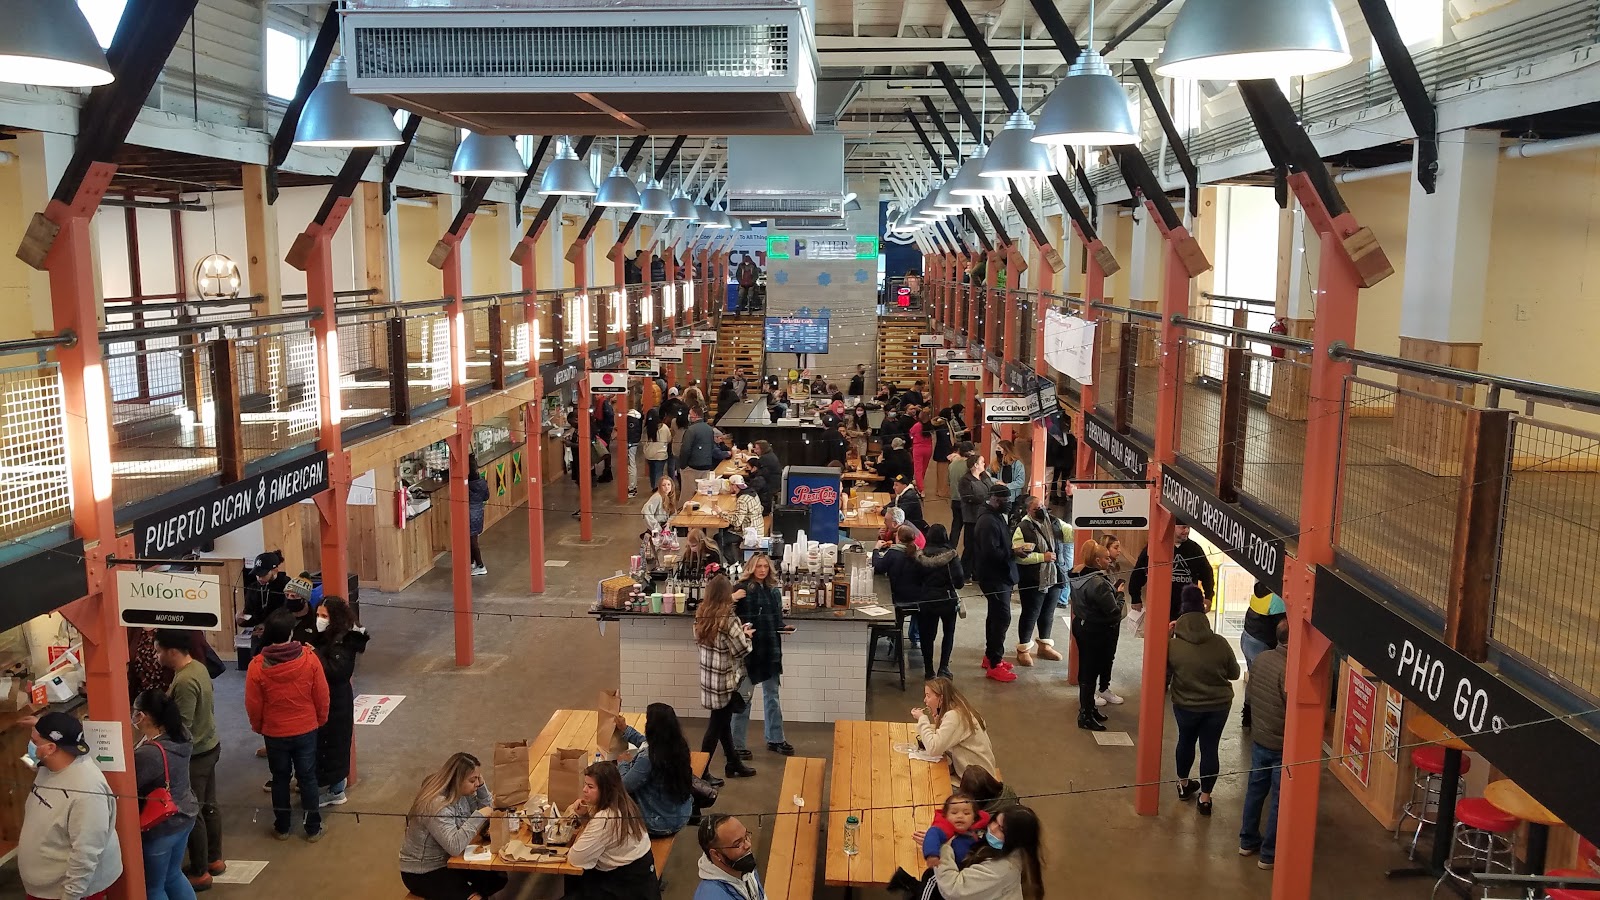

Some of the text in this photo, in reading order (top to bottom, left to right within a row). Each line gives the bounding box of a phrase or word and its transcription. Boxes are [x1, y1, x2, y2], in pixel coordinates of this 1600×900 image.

[145, 506, 206, 557] PUERTO
[211, 488, 252, 529] RICAN
[269, 460, 324, 504] AMERICAN
[1101, 498, 1122, 507] GULA
[1163, 474, 1277, 576] ECCENTRIC BRAZILIAN FOOD
[1398, 640, 1488, 733] PHO GO
